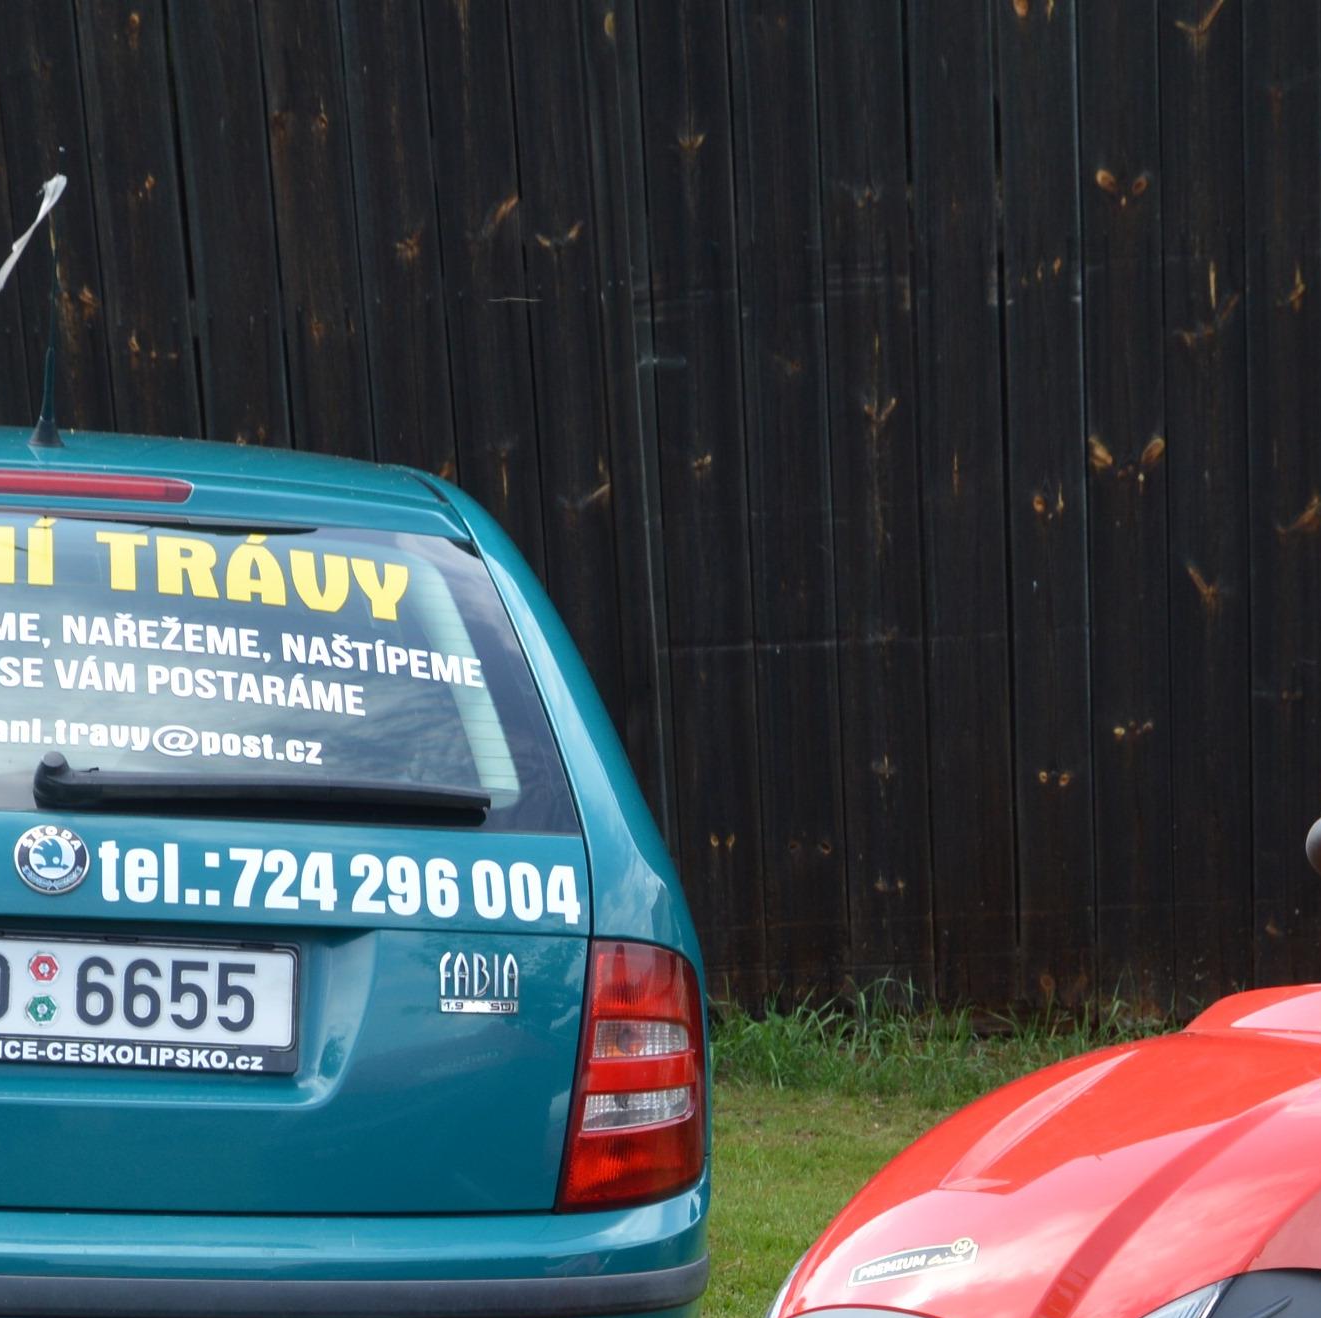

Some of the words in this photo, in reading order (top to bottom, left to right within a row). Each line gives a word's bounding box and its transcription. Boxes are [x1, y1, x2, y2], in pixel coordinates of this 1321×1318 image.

[96, 533, 409, 621] TRÁVY
[62, 612, 272, 664] NAŘEŽEME,
[282, 632, 485, 689] NAŠTÍPEME
[54, 659, 136, 694] VÁM
[147, 666, 367, 717] POSTARÁME
[349, 853, 460, 919] 296
[472, 859, 582, 926] 004
[76, 955, 257, 1034] 6655
[439, 951, 519, 998] FABIA
[858, 1254, 926, 1280] PREMIUM
